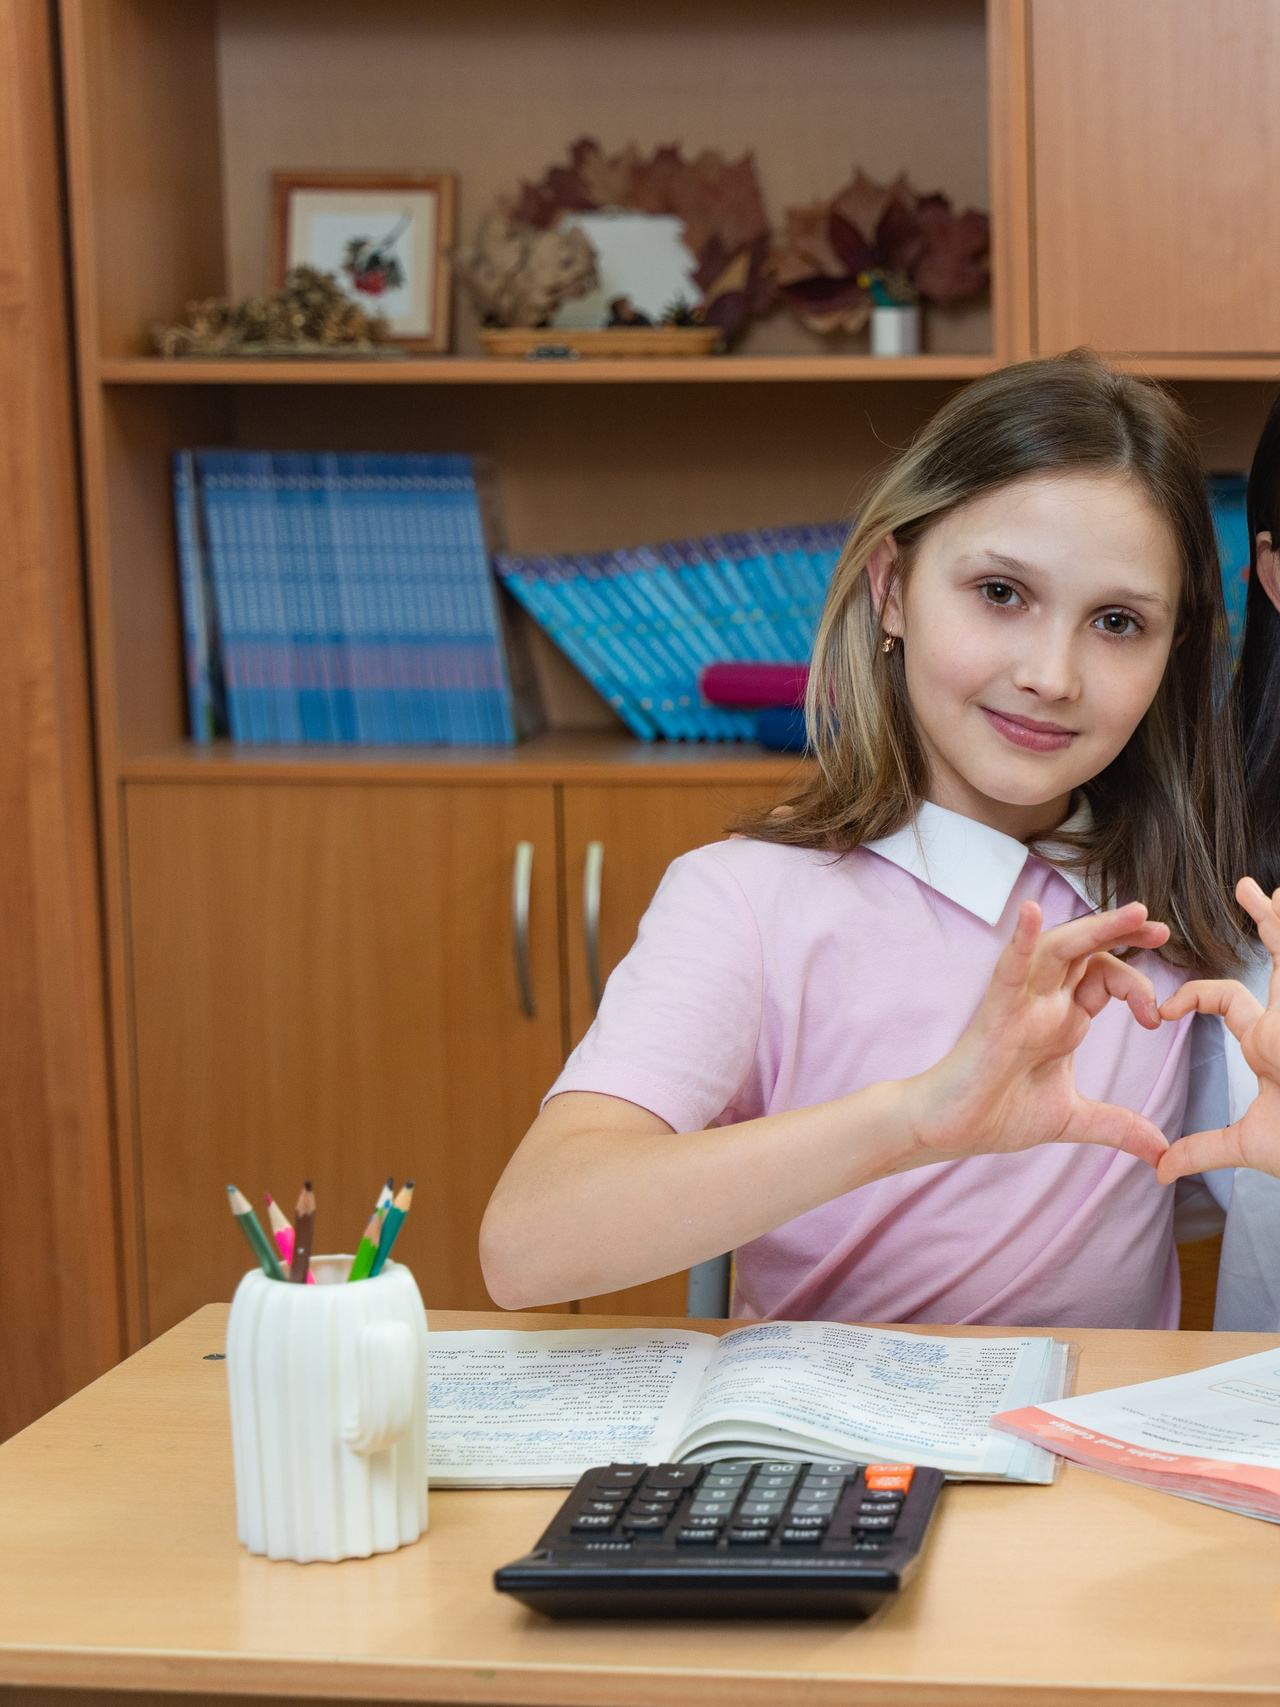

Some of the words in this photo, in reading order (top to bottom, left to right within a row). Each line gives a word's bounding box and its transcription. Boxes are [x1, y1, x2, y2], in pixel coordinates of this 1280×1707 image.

[769, 1464, 795, 1472] 00
[827, 1465, 842, 1473] 0
[720, 1477, 733, 1486] 3
[712, 1490, 727, 1499] 6
[763, 1490, 777, 1499] 5
[814, 1491, 829, 1499] 4
[705, 1503, 720, 1511] 9
[756, 1503, 770, 1512] 8
[808, 1503, 820, 1511] 7
[579, 1515, 611, 1524] MU
[792, 1517, 823, 1525] MR
[858, 1517, 890, 1525] MC
